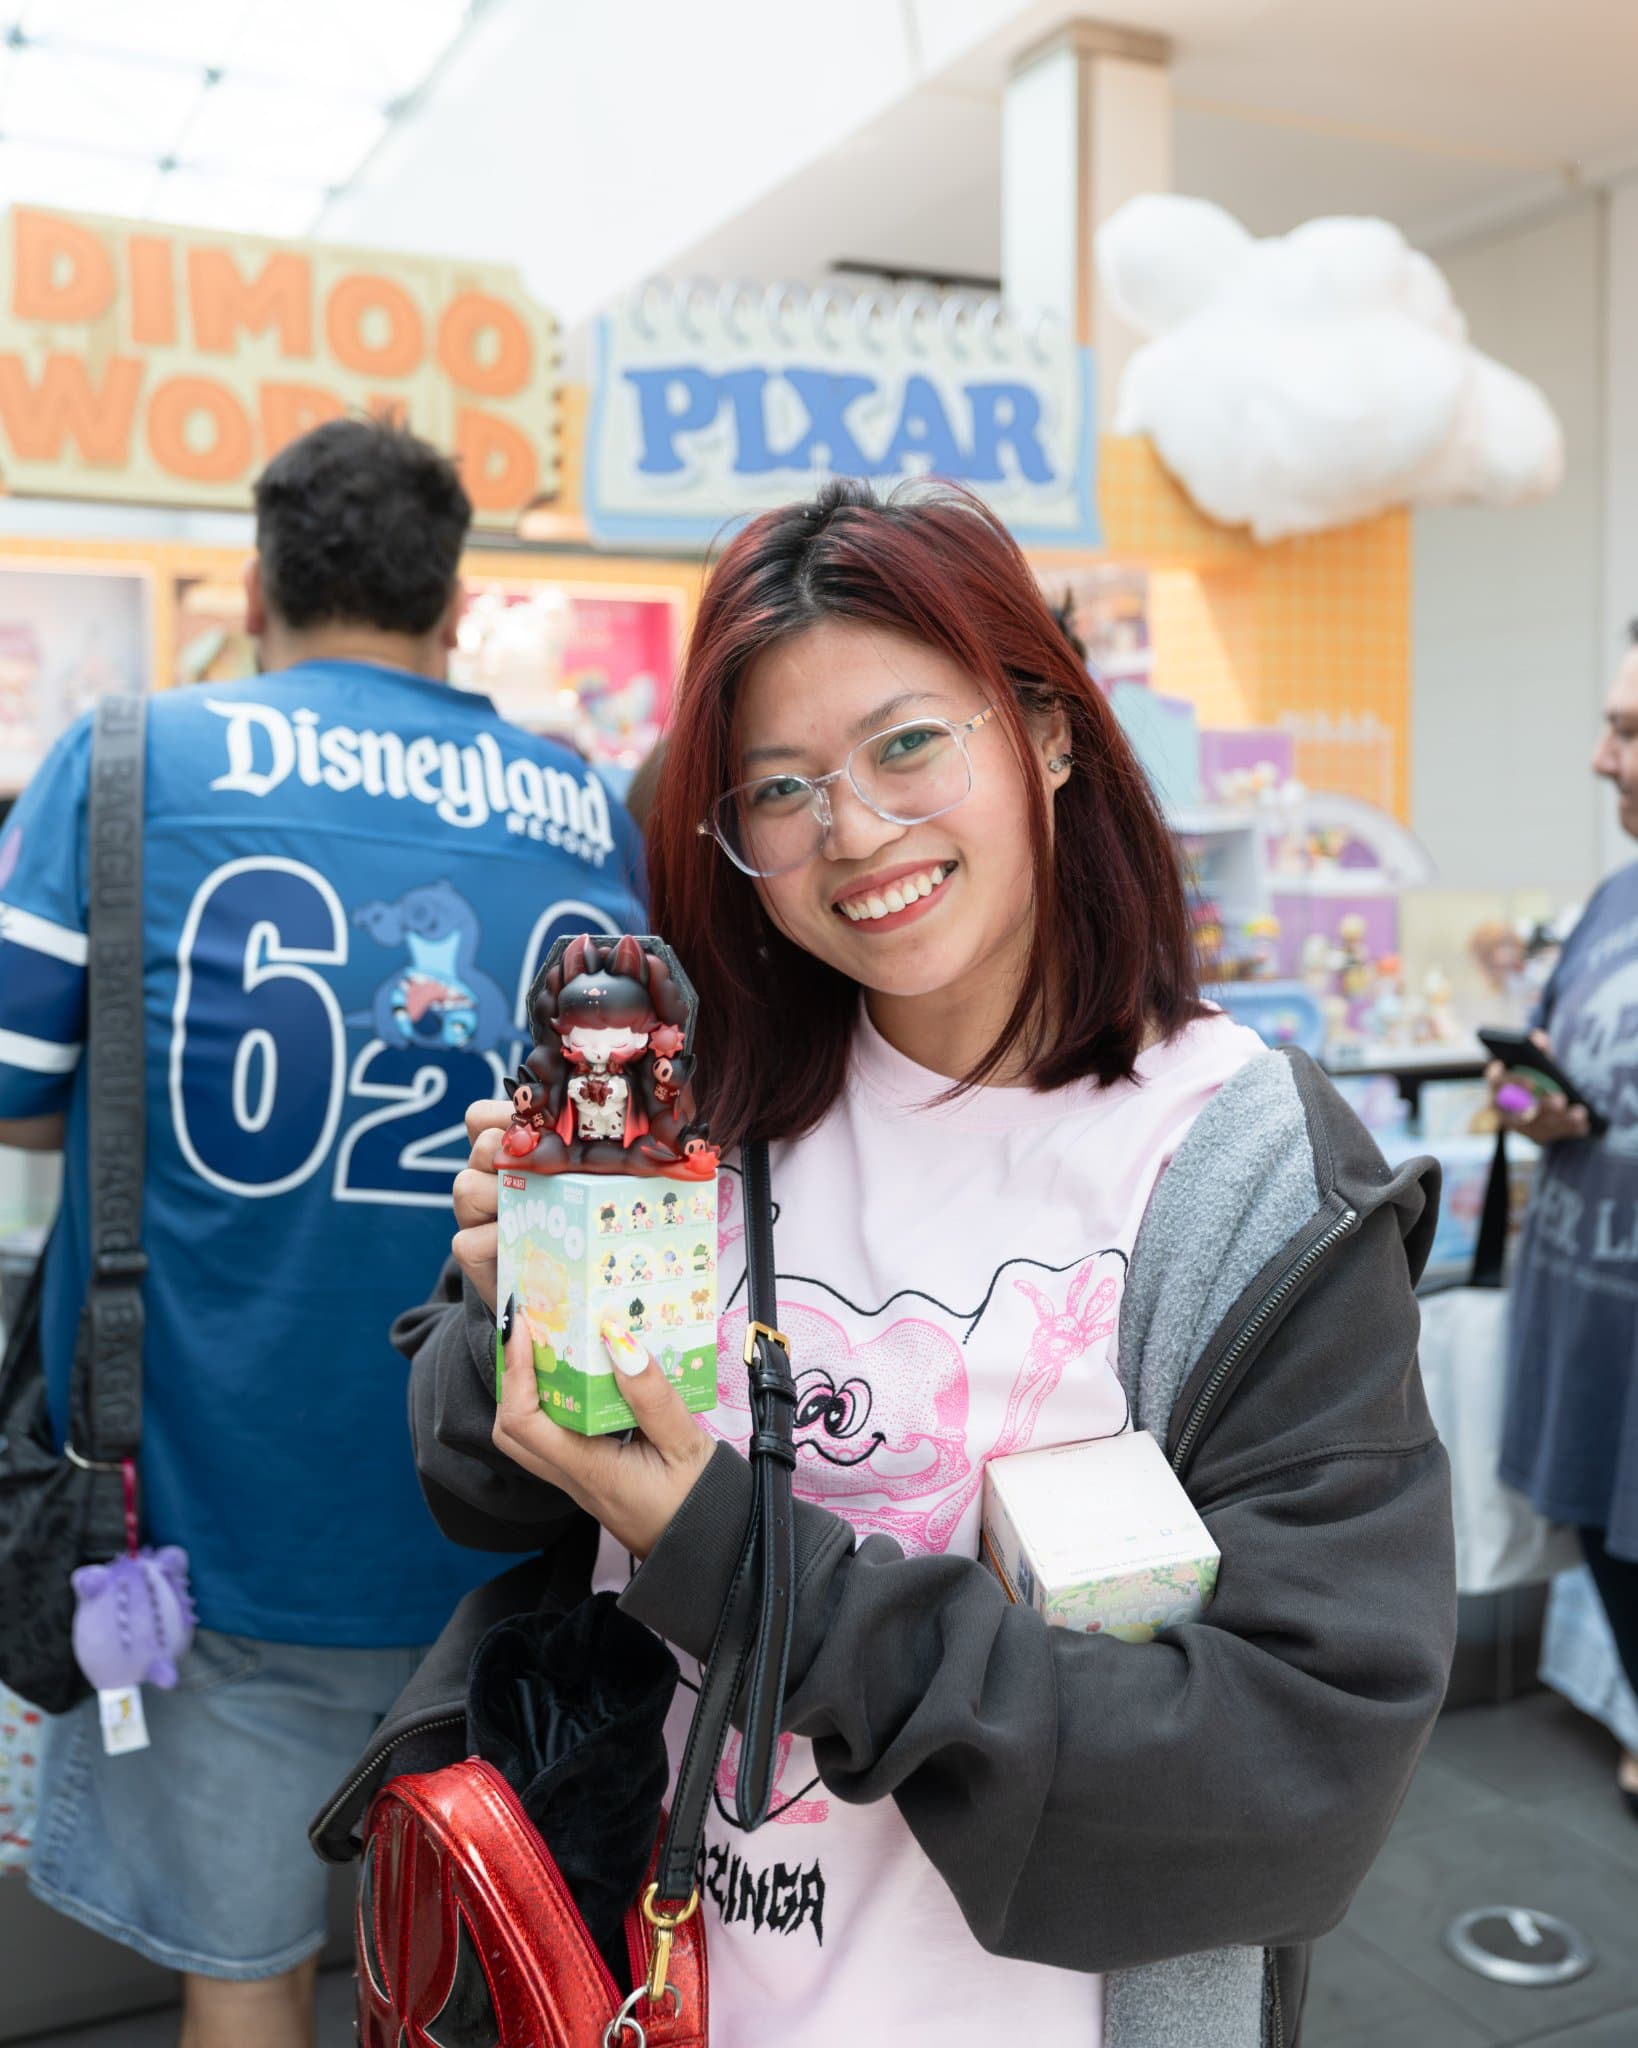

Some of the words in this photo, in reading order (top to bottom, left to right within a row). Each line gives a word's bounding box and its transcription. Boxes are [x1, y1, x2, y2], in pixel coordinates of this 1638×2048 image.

[12, 209, 534, 398] DIMOO
[623, 364, 1056, 484] PIXAR
[205, 697, 616, 852] Disneyland
[96, 757, 136, 909] BAGGU
[504, 812, 606, 868] RESORT
[503, 1175, 512, 1187] POP
[513, 1178, 525, 1189] MART
[501, 1199, 585, 1260] DIMOO
[553, 1391, 581, 1413] Side
